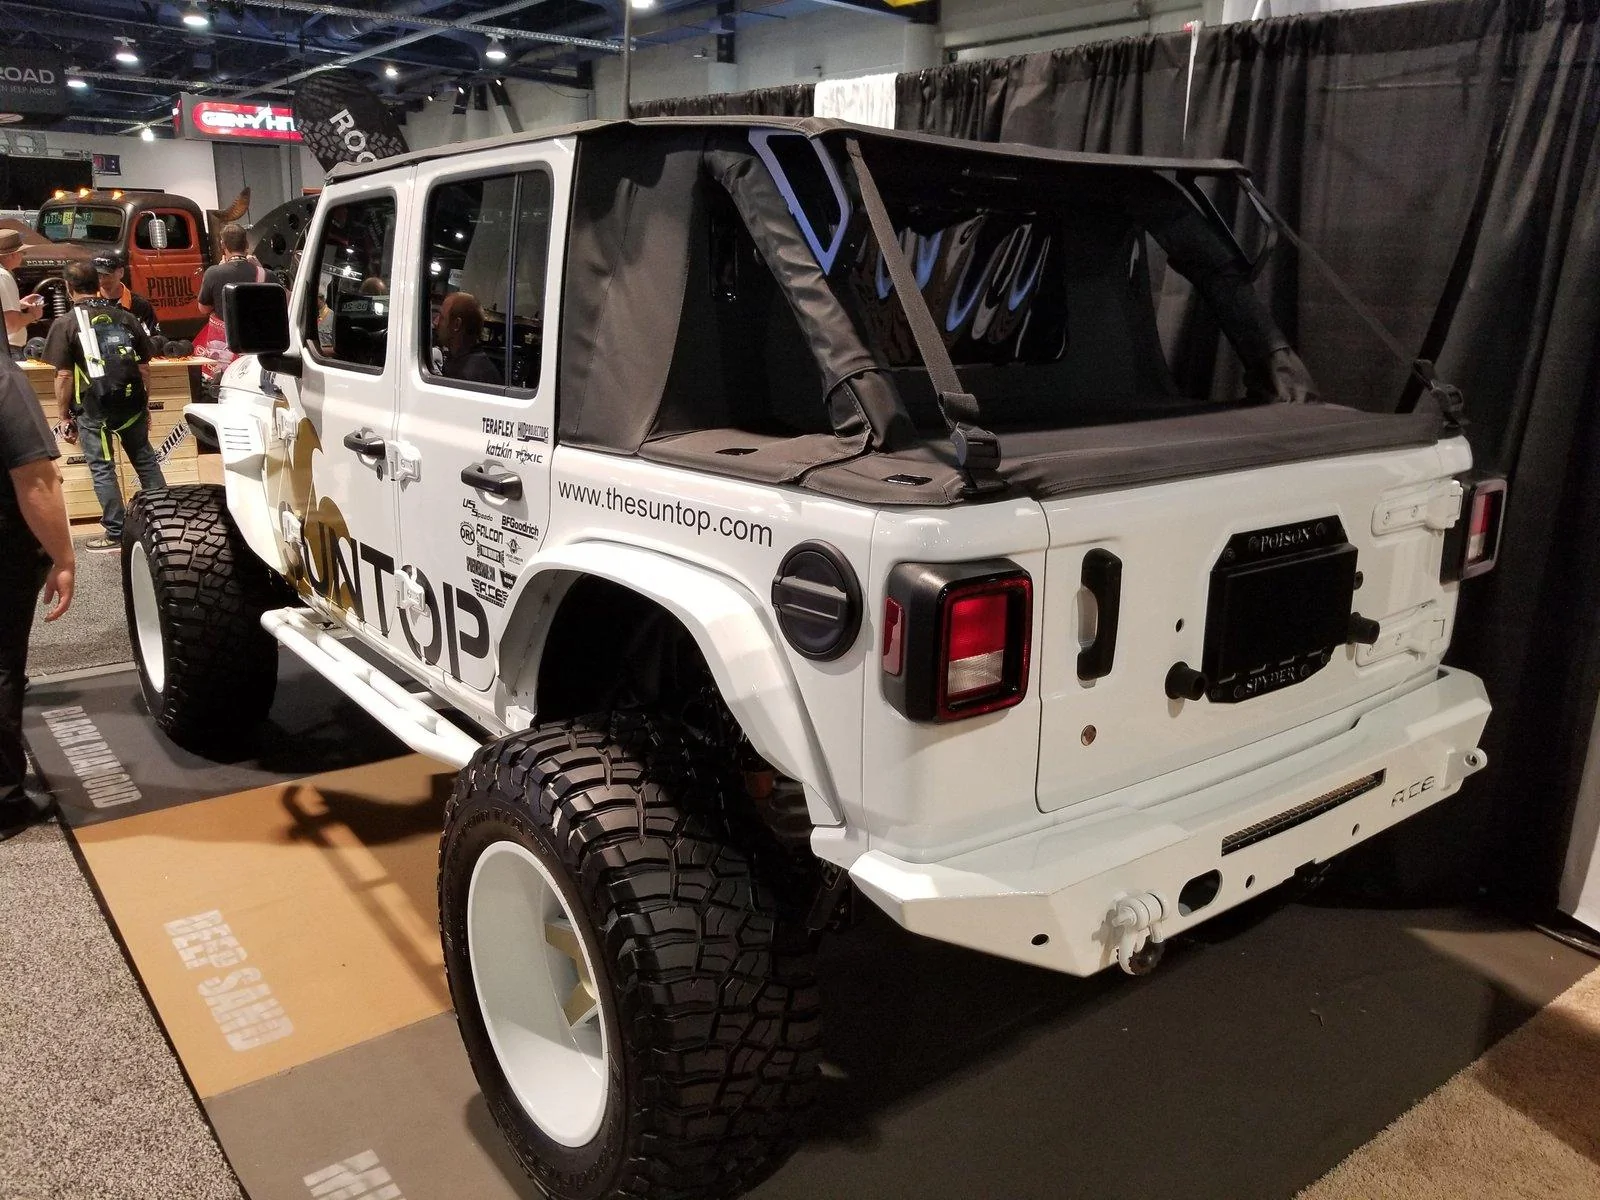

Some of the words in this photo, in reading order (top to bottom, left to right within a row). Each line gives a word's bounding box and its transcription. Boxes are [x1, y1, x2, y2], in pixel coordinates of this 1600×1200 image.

[482, 417, 515, 438] TERAFLEX
[502, 515, 539, 537] BFGoodrich
[558, 481, 773, 547] www.thesuntop.com
[476, 523, 504, 544] FALCON
[1391, 775, 1435, 807] ACE
[163, 909, 248, 970] DEEP
[197, 966, 294, 1052] SAND
